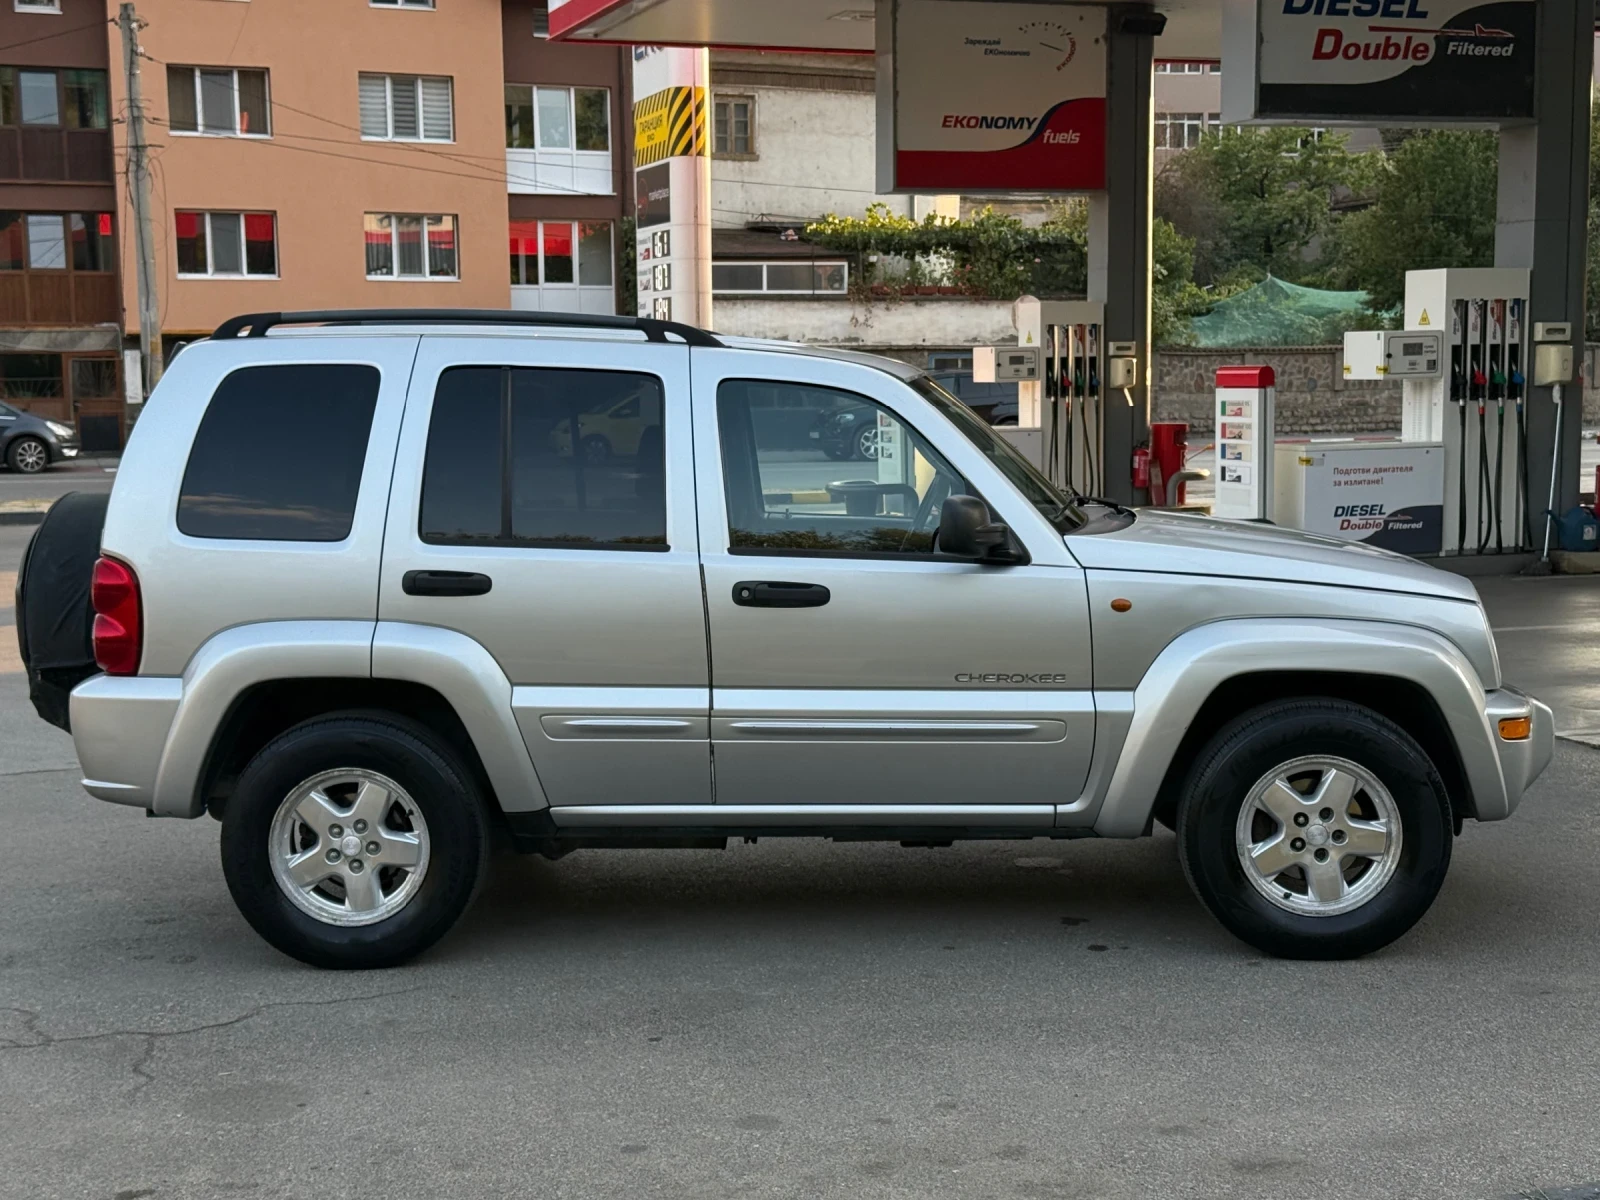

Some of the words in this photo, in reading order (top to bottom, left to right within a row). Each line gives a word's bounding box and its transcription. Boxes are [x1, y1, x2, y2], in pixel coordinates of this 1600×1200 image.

[964, 37, 1001, 46] Зареждай
[1312, 28, 1430, 61] Double
[1446, 41, 1514, 57] Filtered
[941, 115, 1038, 130] EKONOMY
[1043, 129, 1080, 144] fuels
[1333, 467, 1371, 476] Подготви
[1372, 465, 1414, 475] двигателя
[1343, 477, 1384, 487] излитане!
[1334, 504, 1386, 517] DIESEL
[1339, 519, 1383, 531] Double
[1387, 521, 1423, 531] Filtered
[954, 673, 1066, 684] CHEROKEE
